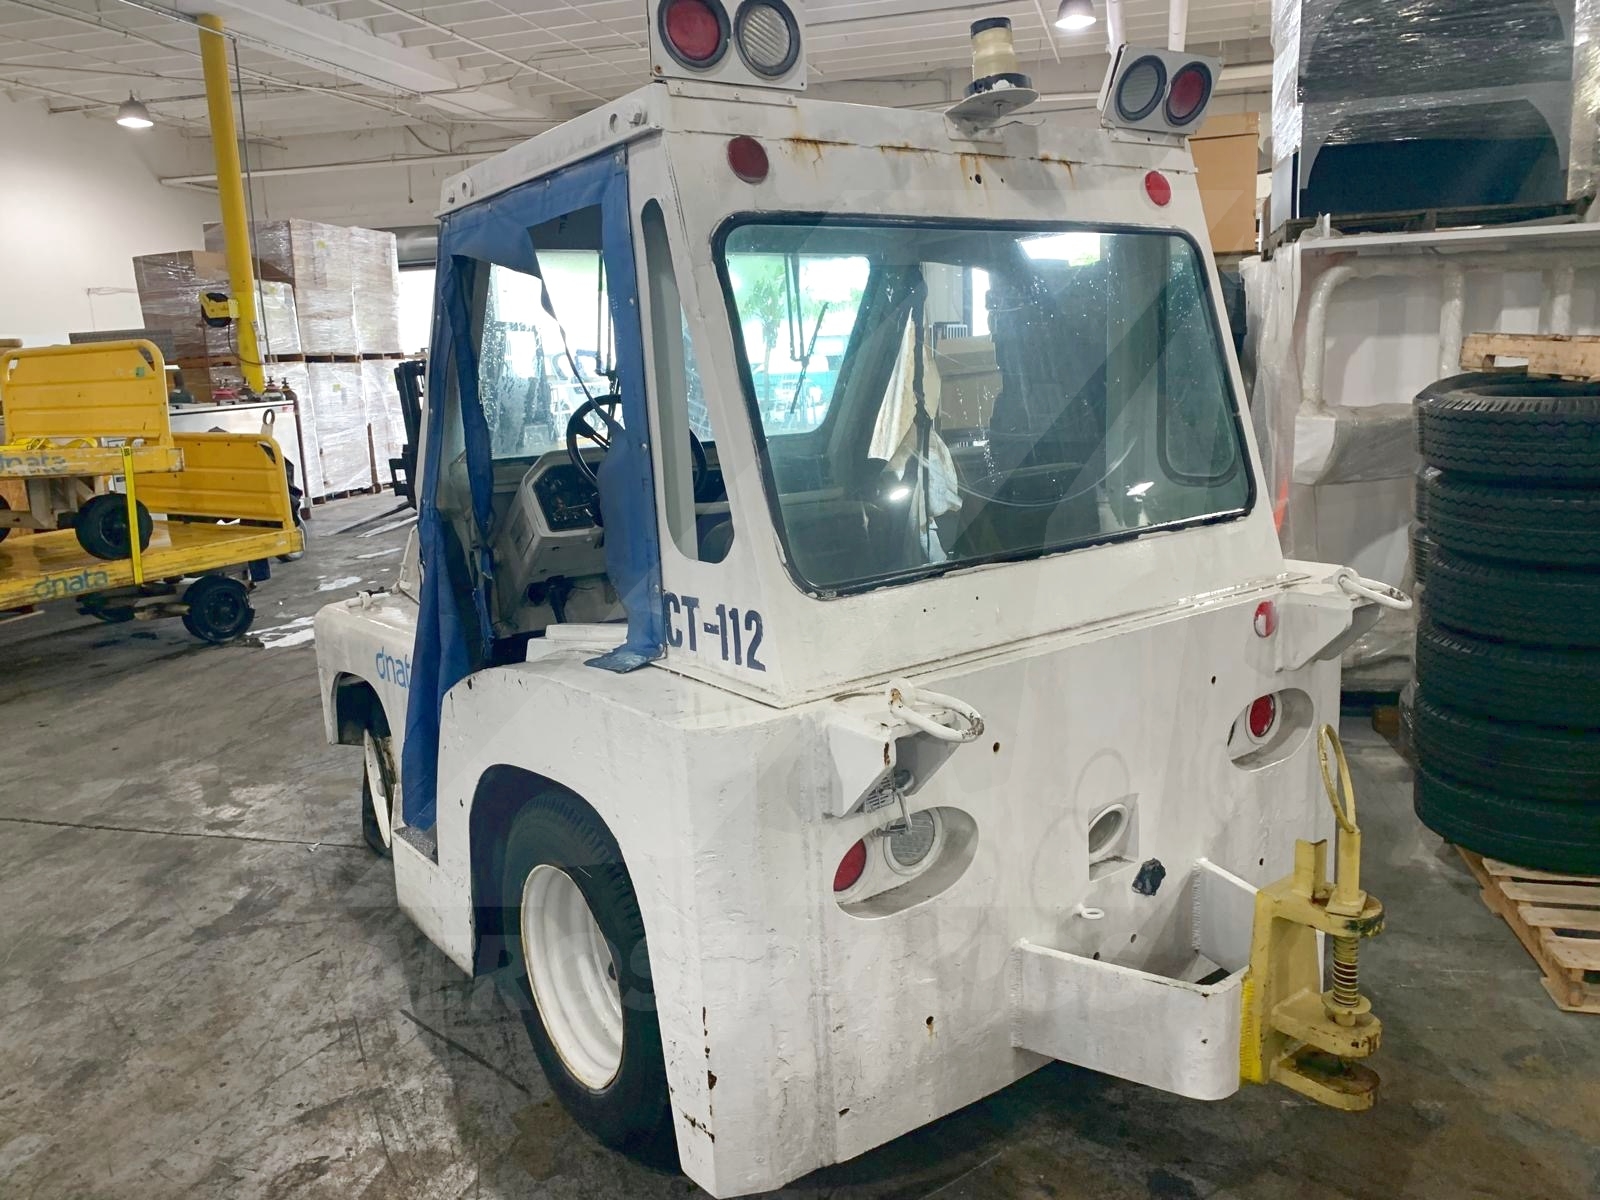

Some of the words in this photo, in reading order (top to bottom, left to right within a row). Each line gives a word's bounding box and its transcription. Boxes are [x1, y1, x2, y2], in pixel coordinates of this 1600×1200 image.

[0, 452, 67, 474] nata
[33, 568, 108, 598] dnata
[664, 592, 766, 672] CT-112
[375, 645, 411, 688] dnat
